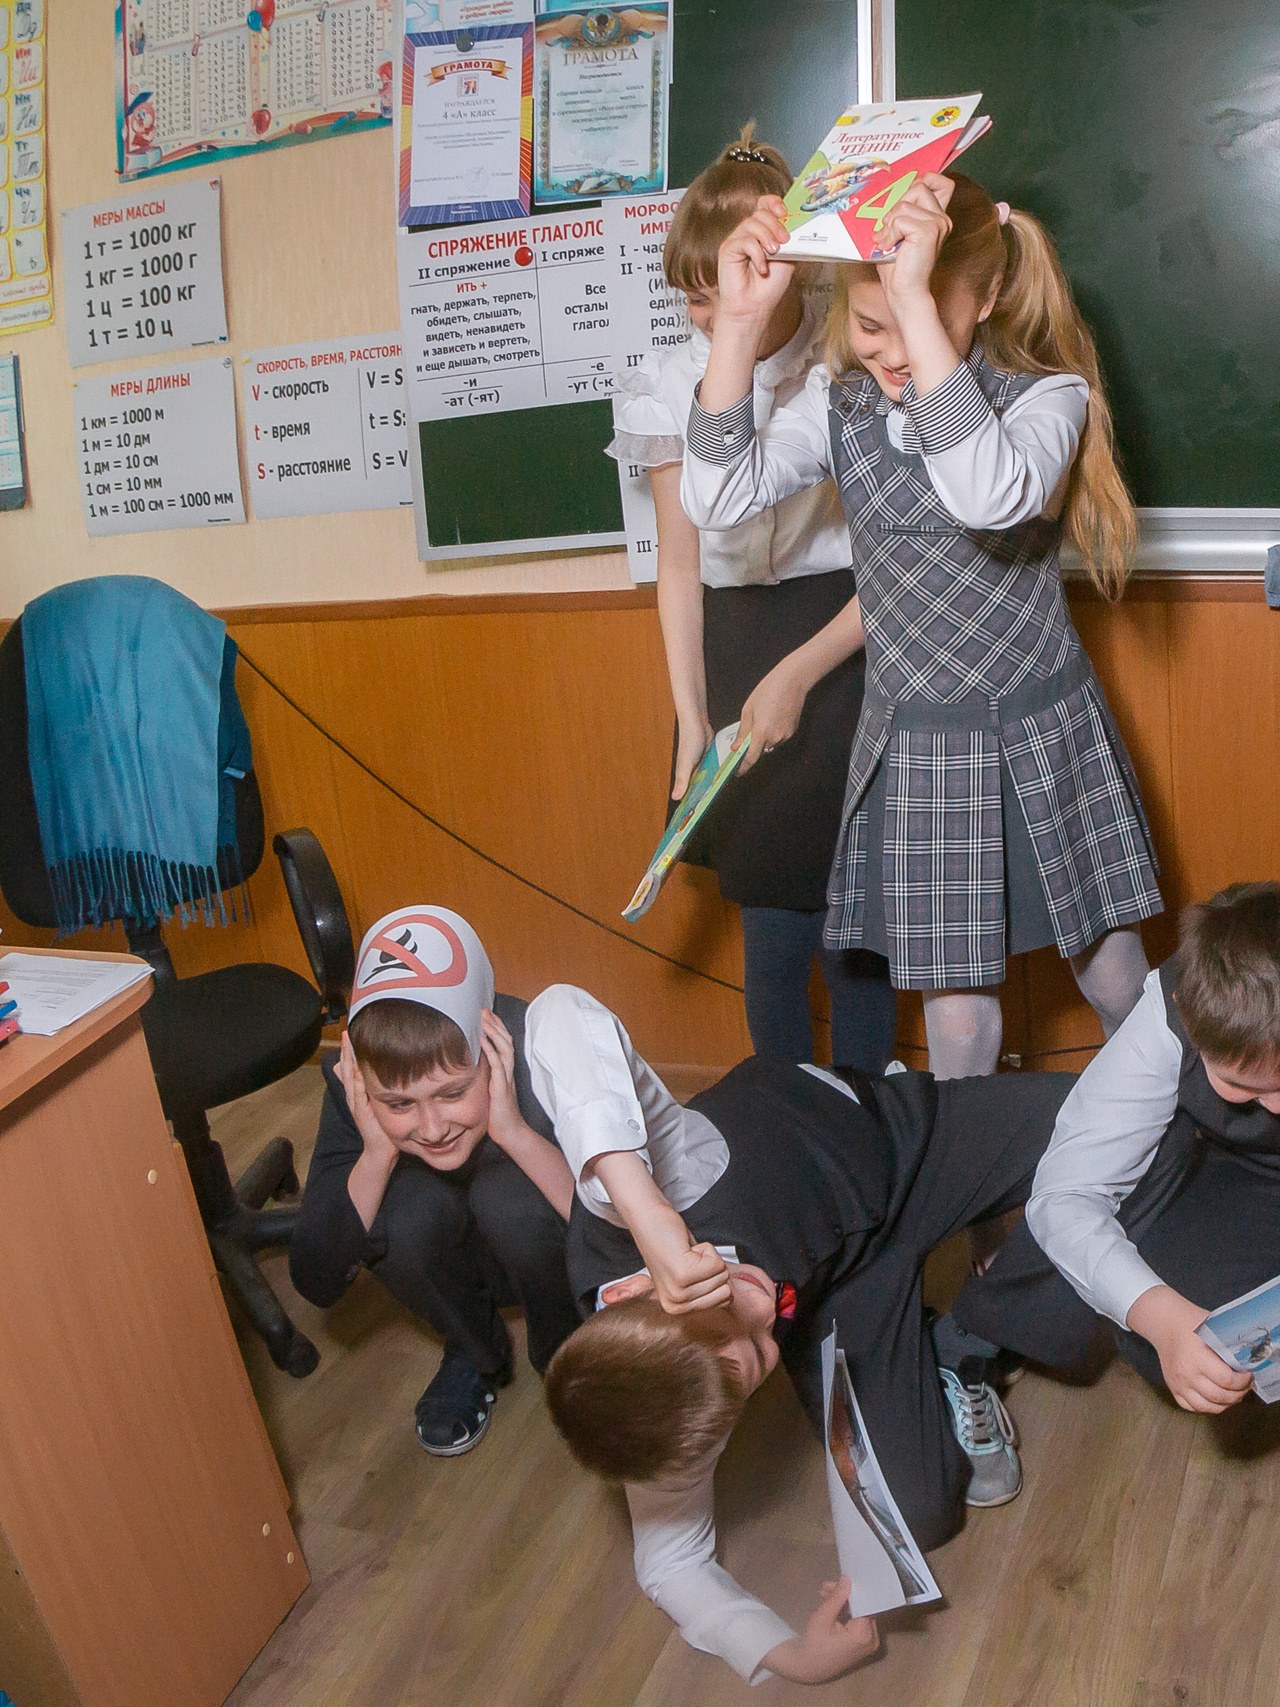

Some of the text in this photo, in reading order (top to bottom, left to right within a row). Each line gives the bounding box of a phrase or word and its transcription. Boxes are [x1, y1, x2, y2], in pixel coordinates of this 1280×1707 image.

[444, 61, 493, 73] ГРАМОТА
[563, 48, 639, 66] ГРАМОТА
[832, 132, 924, 144] Литературное
[840, 141, 903, 154] ЧТЕНИЕ
[856, 171, 918, 231] 4
[93, 200, 165, 228] МЕРЫ МАССЫ
[84, 223, 196, 259] 1 т = 1000 кг
[428, 230, 527, 258] СПРЯЖЕНИЕ
[620, 245, 626, 257] I
[542, 251, 548, 262] I
[86, 252, 197, 288] 1 кг = 1000 г
[418, 258, 510, 279] II спряжение
[621, 263, 632, 275] II
[586, 284, 606, 295] Все
[87, 285, 195, 318] 1 ц = 100 кг
[411, 291, 536, 315] гнать, держать, терпеть,
[427, 308, 522, 327] обидеть, слышать,
[89, 318, 173, 347] 1 т = 10 ц
[426, 322, 526, 342] видеть, ненавидеть
[432, 343, 476, 356] зависеть
[488, 336, 530, 350] вертеть,
[257, 358, 308, 374] СКОРОСТЬ,
[311, 352, 347, 367] ВРЕМЯ,
[425, 362, 445, 371] еще
[448, 356, 491, 370] дышать,
[493, 349, 540, 362] смотреть
[591, 362, 604, 371] -е
[111, 373, 190, 397] МЕРЫ ДЛИНЫ
[367, 368, 403, 388] V = S
[464, 378, 477, 387] -и
[568, 380, 588, 393] -ут
[252, 385, 260, 401] V
[273, 380, 329, 400] скорость
[445, 390, 500, 406] -ат (-ят)
[82, 408, 164, 430] 1 км = 1000 м
[369, 413, 375, 429] t
[380, 416, 388, 425] =
[255, 425, 260, 440] t
[272, 422, 310, 442] время
[83, 433, 150, 452] 1 м = 10 дм
[84, 454, 158, 475] 1 дм = 10 см
[258, 463, 266, 479] S
[278, 458, 351, 482] расстояние
[373, 450, 408, 470] S = V
[629, 465, 639, 477] II
[86, 477, 162, 496] 1 см = 10 мм
[90, 504, 96, 517] 1
[100, 506, 108, 516] м
[123, 499, 145, 514] 100
[148, 500, 163, 511] см
[167, 499, 176, 507] =
[180, 492, 210, 508] 1000
[214, 492, 233, 504] мм
[637, 540, 651, 553] III
